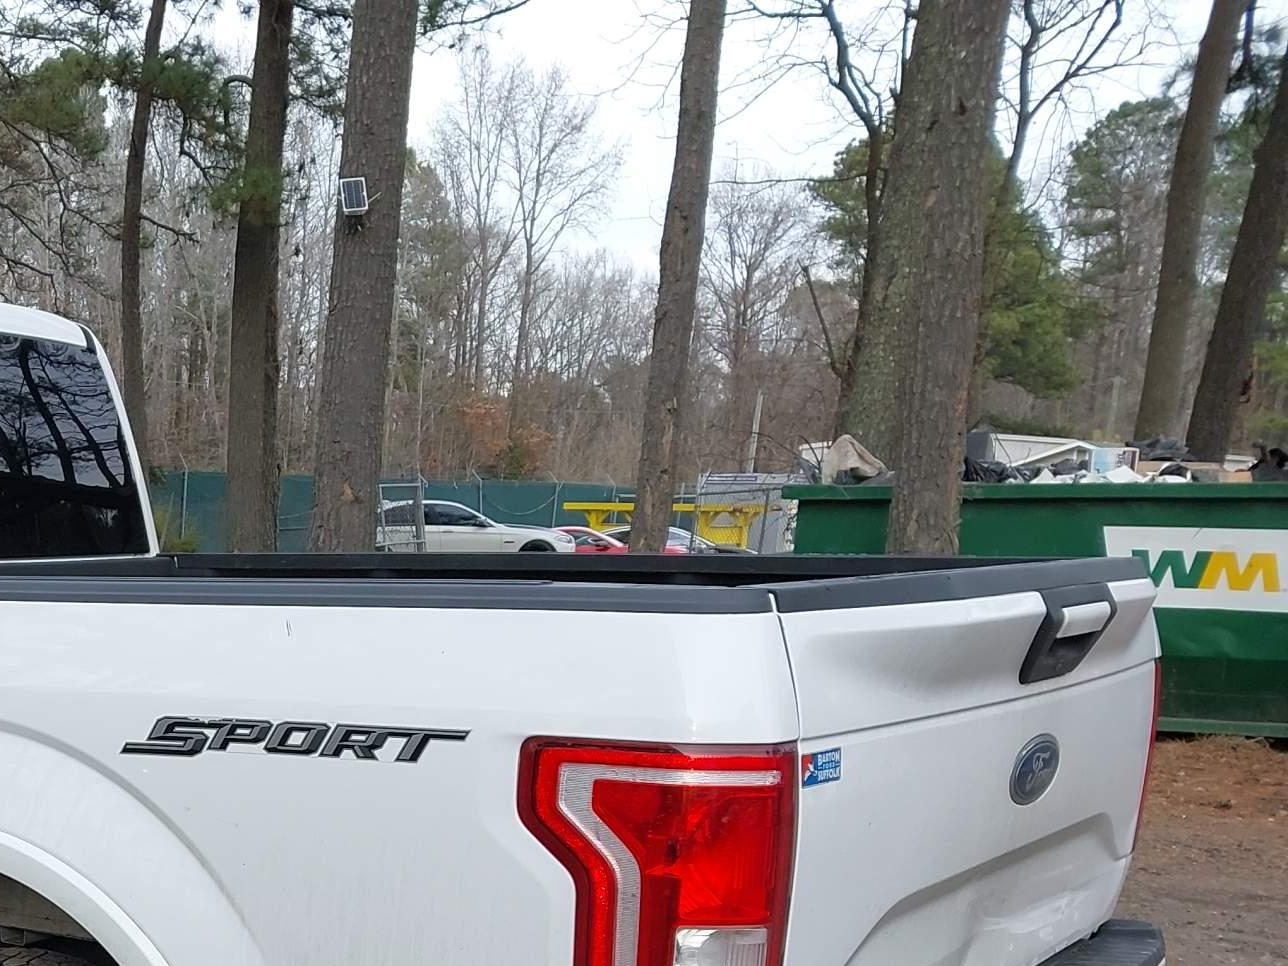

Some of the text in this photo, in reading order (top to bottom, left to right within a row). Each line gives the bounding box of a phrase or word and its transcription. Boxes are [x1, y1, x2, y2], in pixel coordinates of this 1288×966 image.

[1132, 549, 1280, 593] WM
[120, 716, 472, 764] SPORT
[817, 750, 841, 766] BARTON
[817, 767, 841, 782] SUFFOLK
